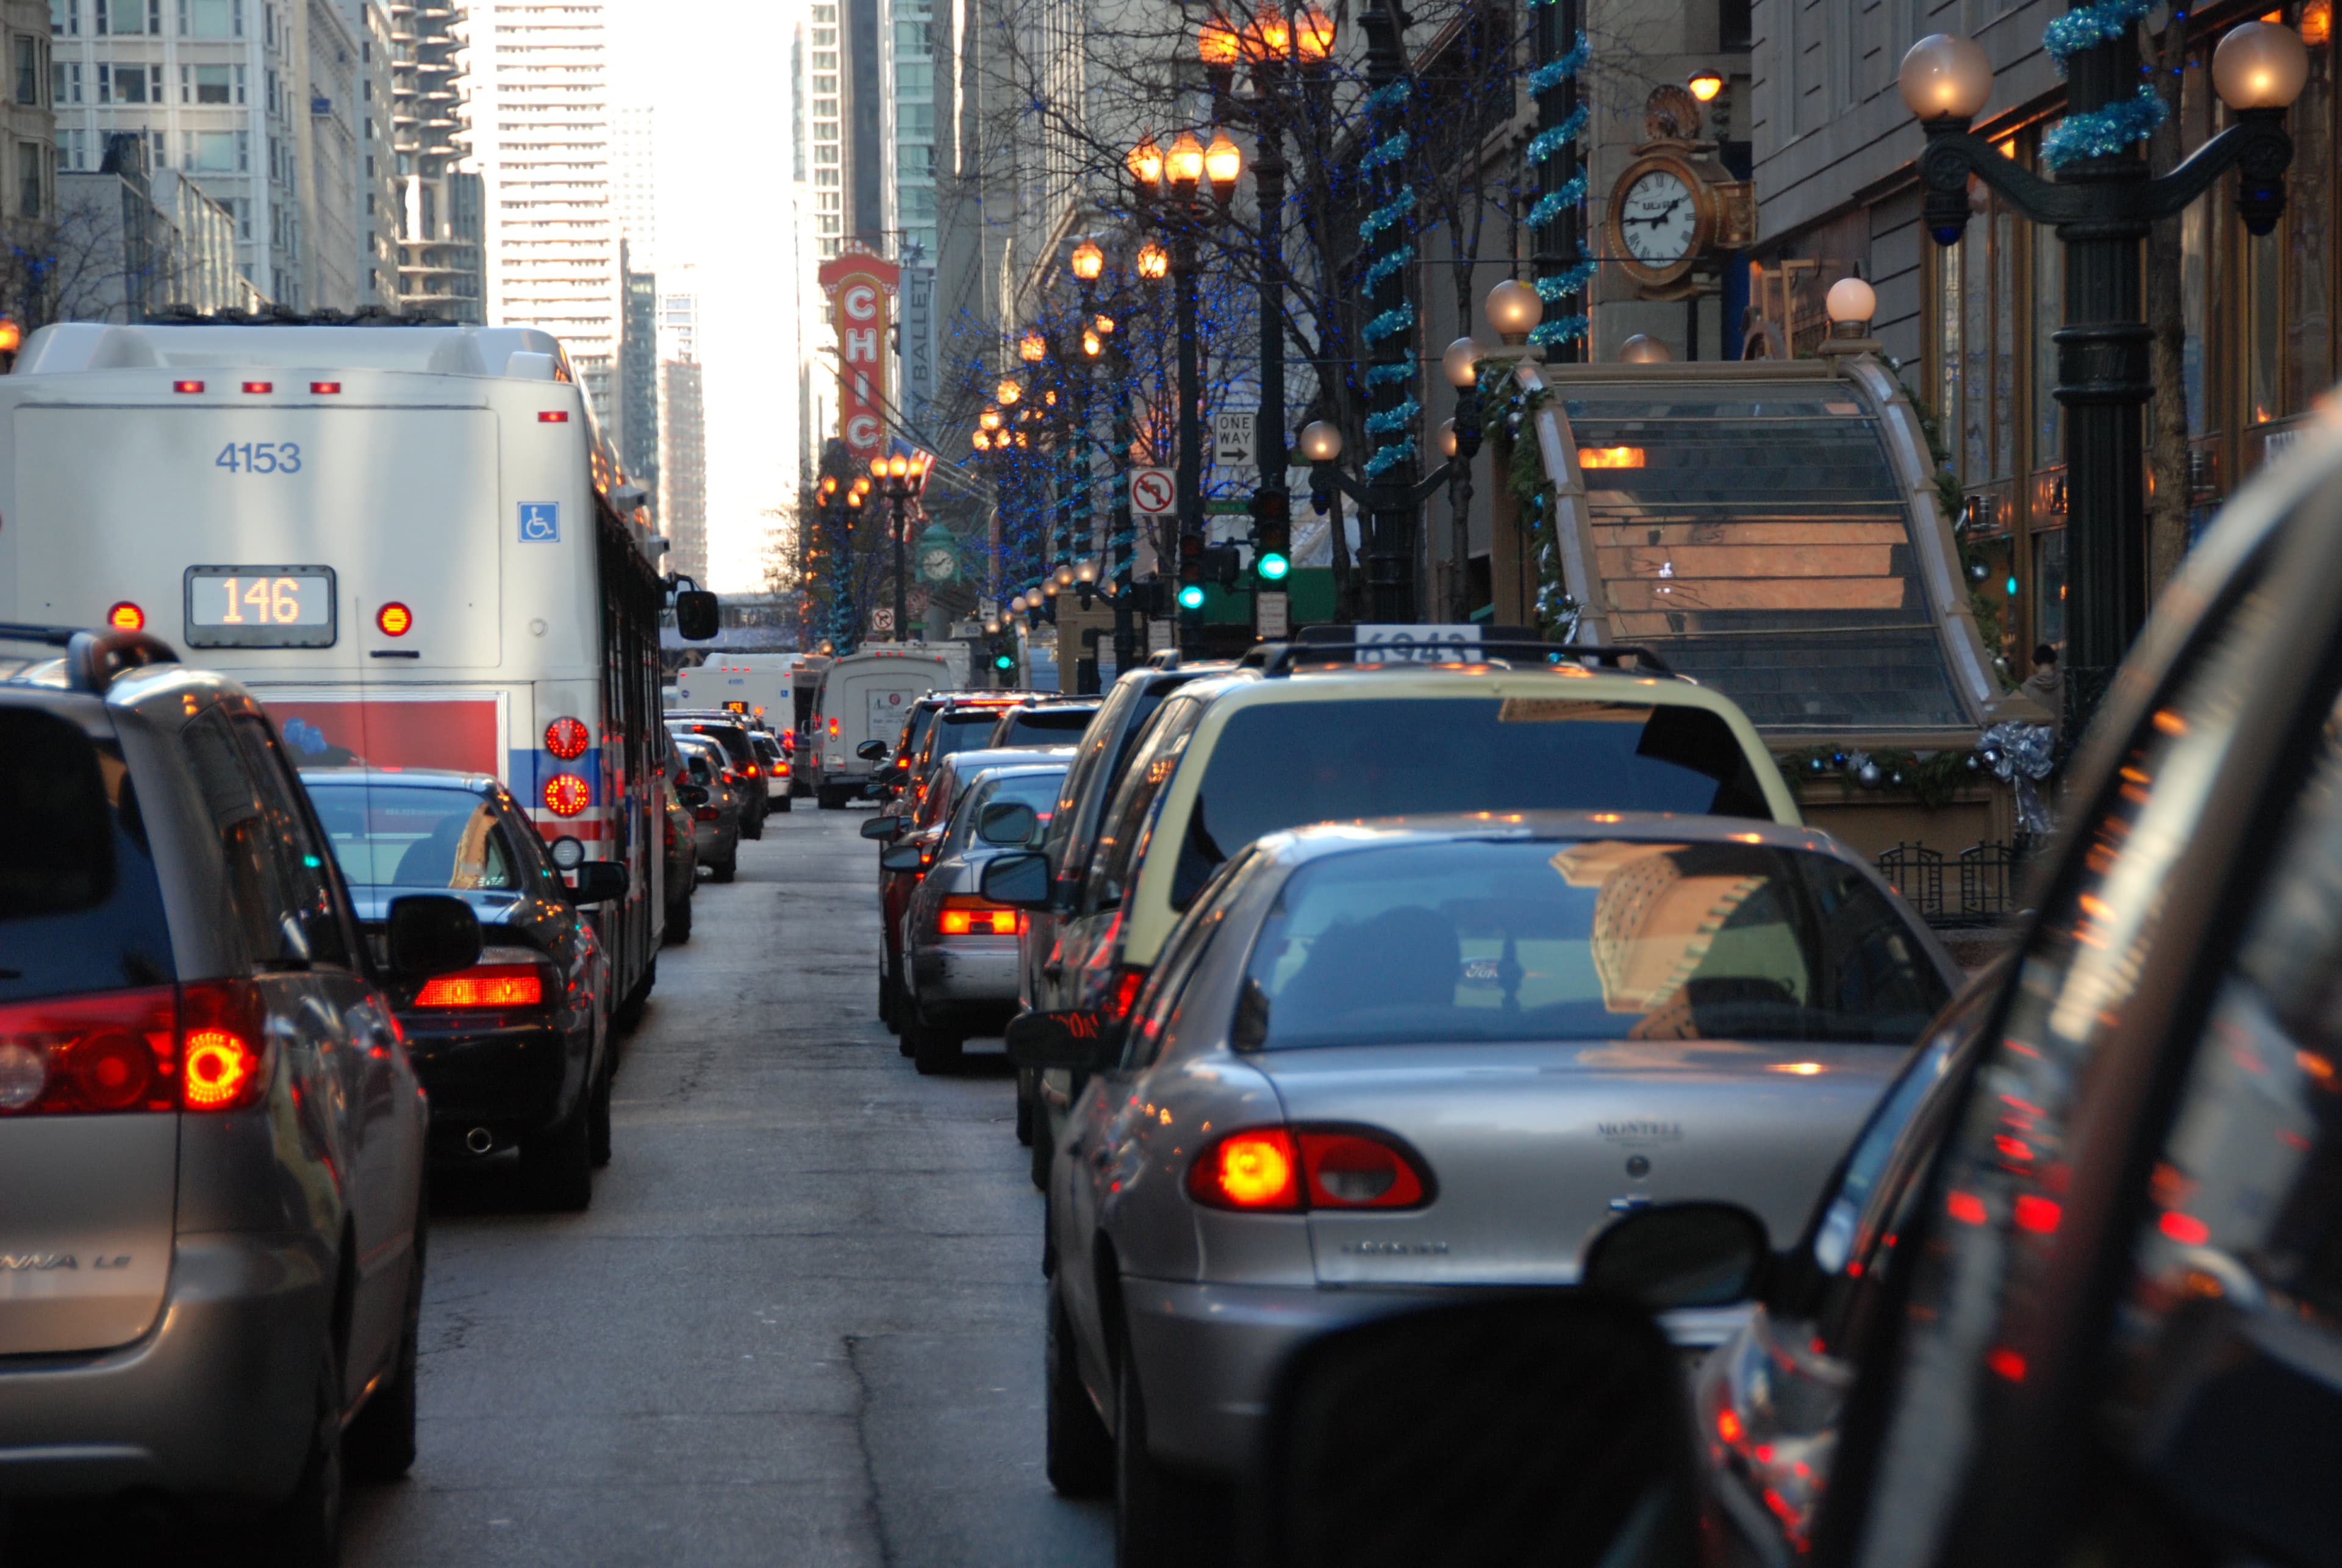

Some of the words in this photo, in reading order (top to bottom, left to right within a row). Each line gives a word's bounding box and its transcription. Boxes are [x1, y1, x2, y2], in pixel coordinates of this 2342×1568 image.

[911, 274, 928, 381] BALLET
[844, 285, 878, 454] CHIC
[1219, 432, 1250, 444] WAY
[1220, 417, 1250, 429] ONE
[216, 442, 302, 474] 4153
[222, 578, 299, 624] 146
[1465, 961, 1499, 979] For
